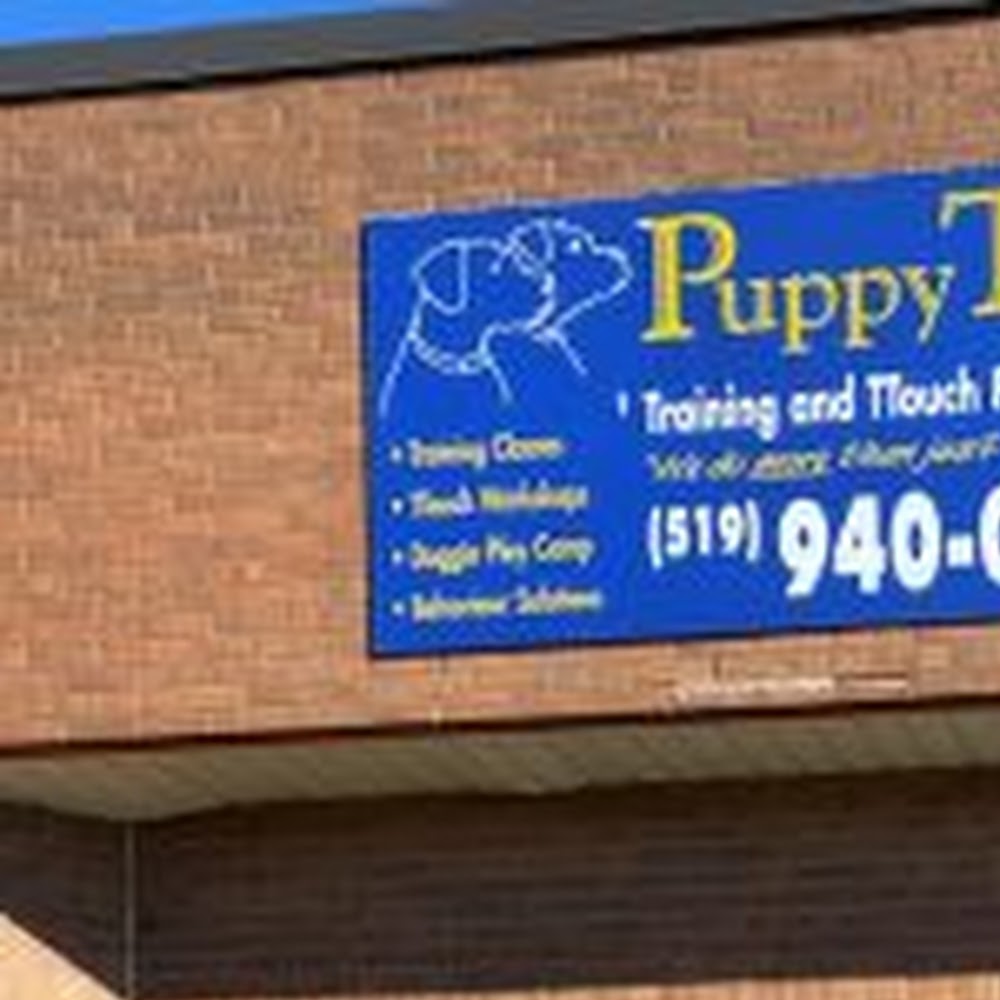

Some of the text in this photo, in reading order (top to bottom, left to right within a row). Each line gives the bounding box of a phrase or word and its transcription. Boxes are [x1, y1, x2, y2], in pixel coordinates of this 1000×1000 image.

[635, 211, 956, 354] Puppy
[641, 380, 778, 441] Training
[788, 373, 855, 423] and
[647, 501, 761, 569] (519)
